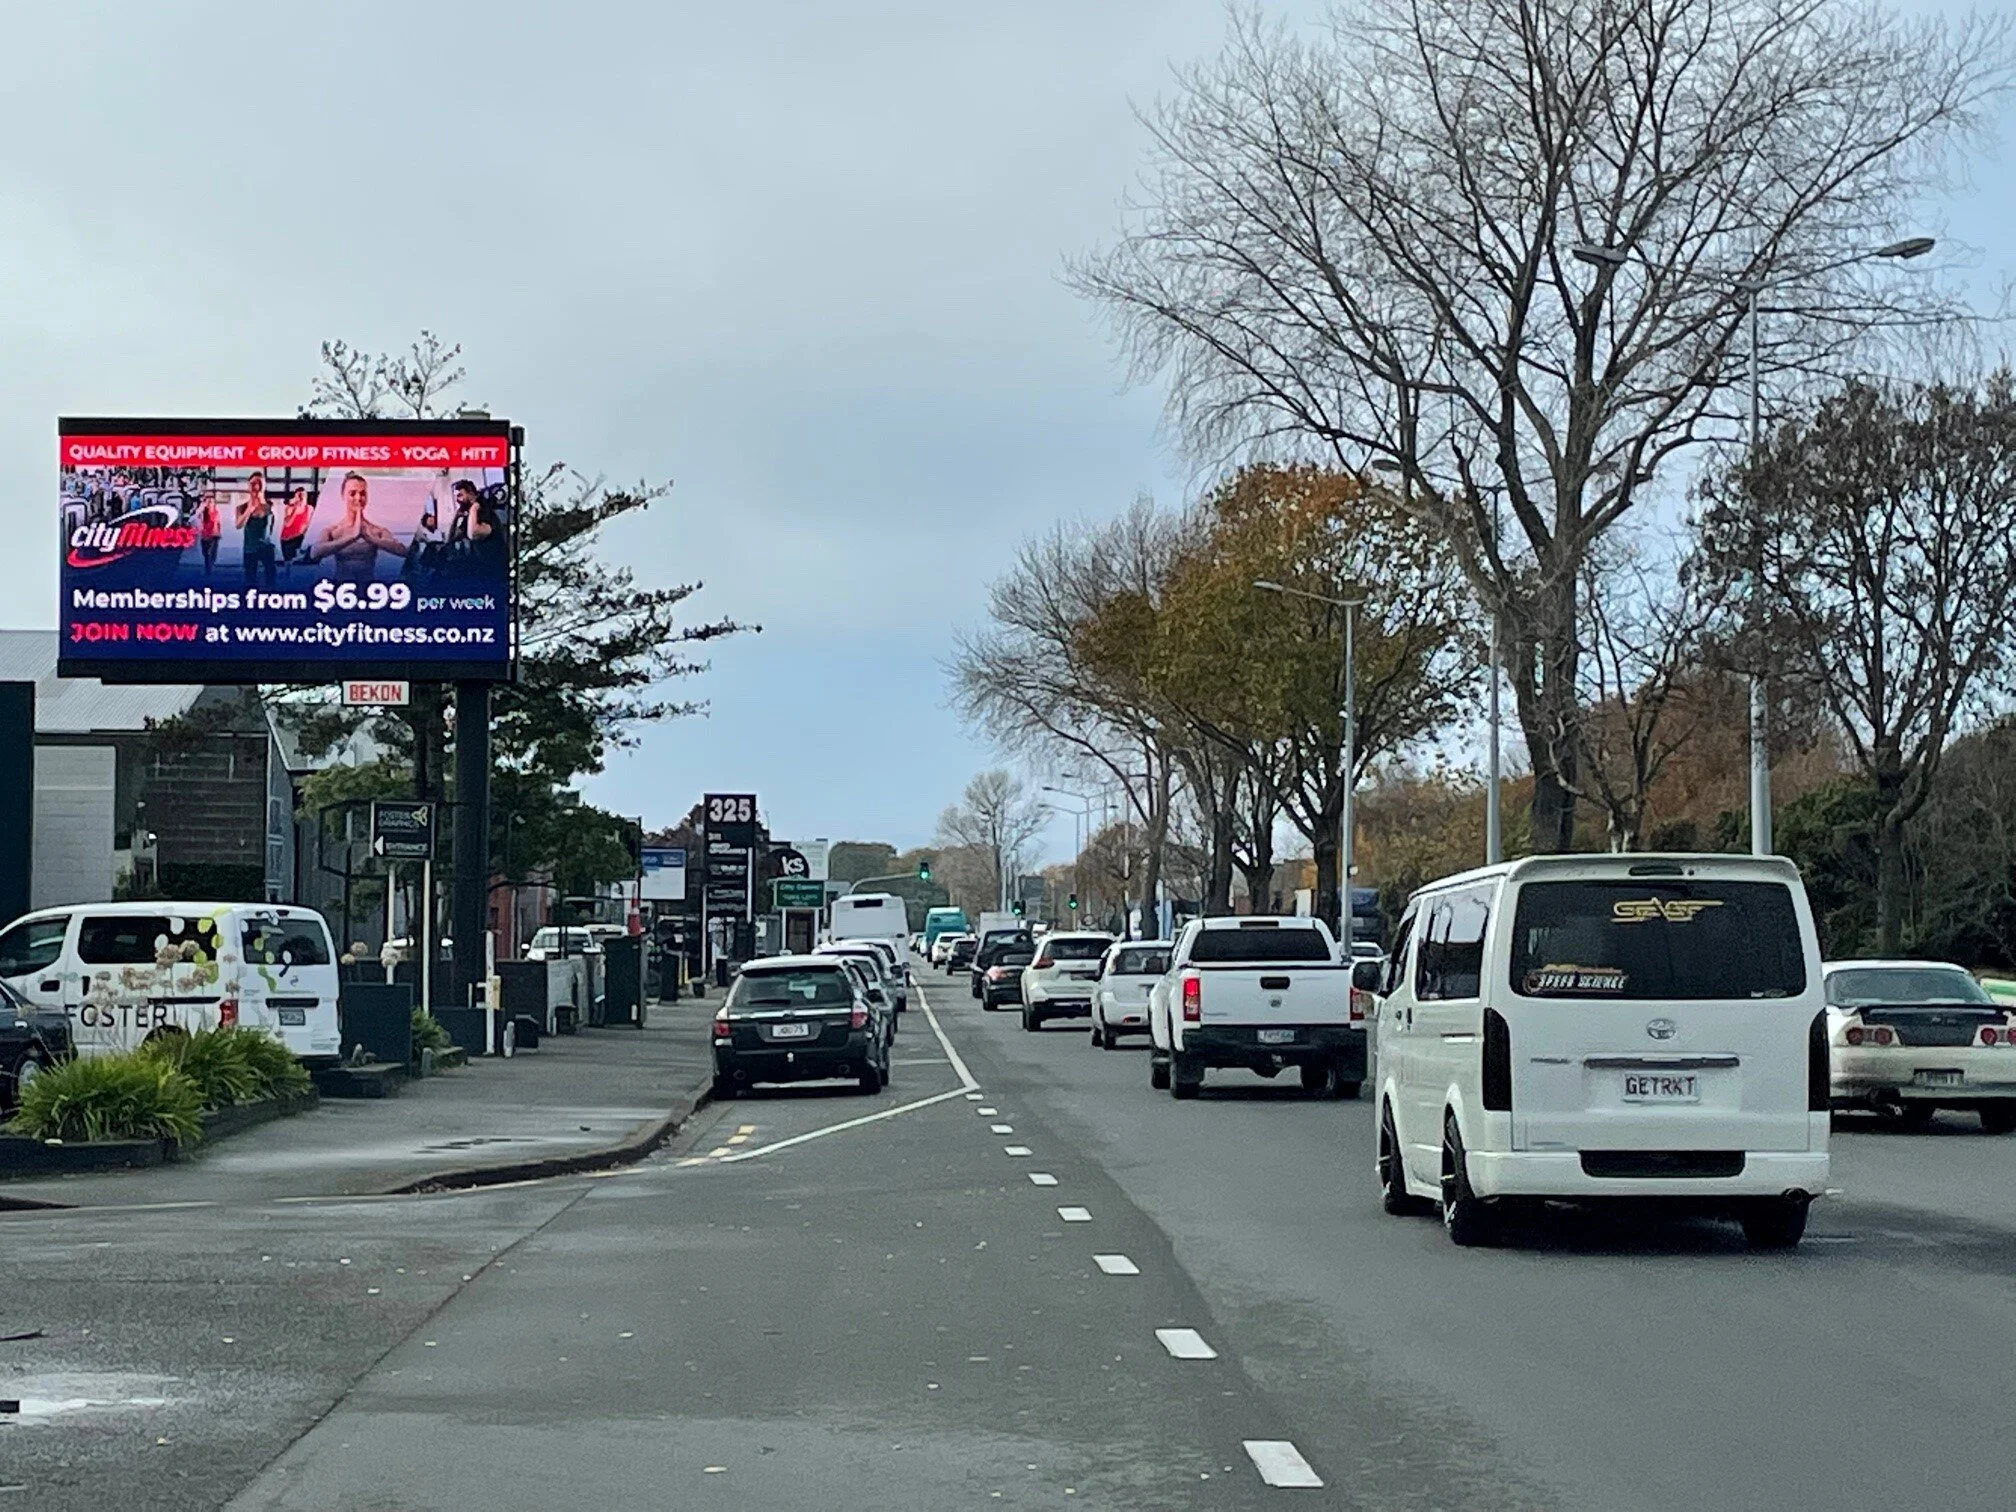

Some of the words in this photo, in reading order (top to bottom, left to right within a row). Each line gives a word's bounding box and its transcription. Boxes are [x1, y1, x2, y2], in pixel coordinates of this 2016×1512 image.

[69, 444, 142, 461] QUALITY
[145, 445, 246, 461] EQUIPMENT
[257, 445, 319, 461] GROUP
[322, 445, 391, 461] FITNESS
[401, 446, 450, 461] YOGA
[461, 446, 499, 461] HITT
[73, 588, 240, 613] Memberships
[246, 589, 307, 609] from
[313, 579, 411, 613] $6.99
[417, 597, 446, 612] per
[450, 594, 495, 610] week
[70, 622, 130, 643] JOIN
[136, 623, 198, 643] NOW
[205, 624, 230, 643] at
[235, 622, 495, 647] www.cityfitness.co.nz
[349, 684, 402, 702] BEKON
[709, 798, 751, 822] 325
[64, 1003, 168, 1028] FOSTER
[1625, 1076, 1696, 1096] GETRKT
